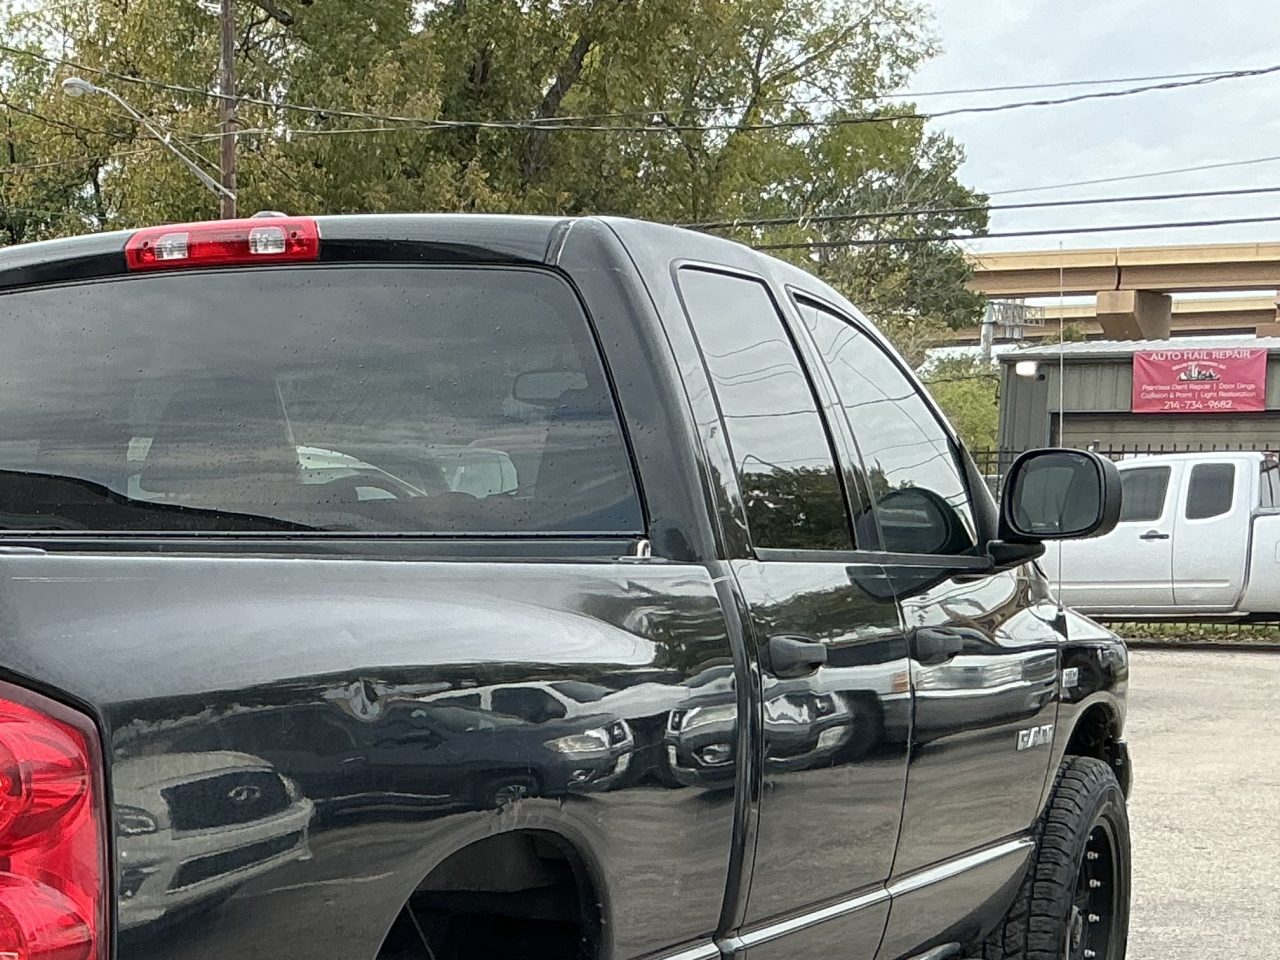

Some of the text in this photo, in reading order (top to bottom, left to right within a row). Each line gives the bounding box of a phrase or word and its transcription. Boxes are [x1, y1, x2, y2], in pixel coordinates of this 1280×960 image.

[1149, 349, 1251, 361] AUTO HAIL REPAIR
[1189, 383, 1211, 391] Repair
[1219, 382, 1235, 390] Door
[1236, 382, 1256, 390] Dings
[1200, 391, 1217, 399] Light
[1163, 399, 1233, 410] 214-734-9682
